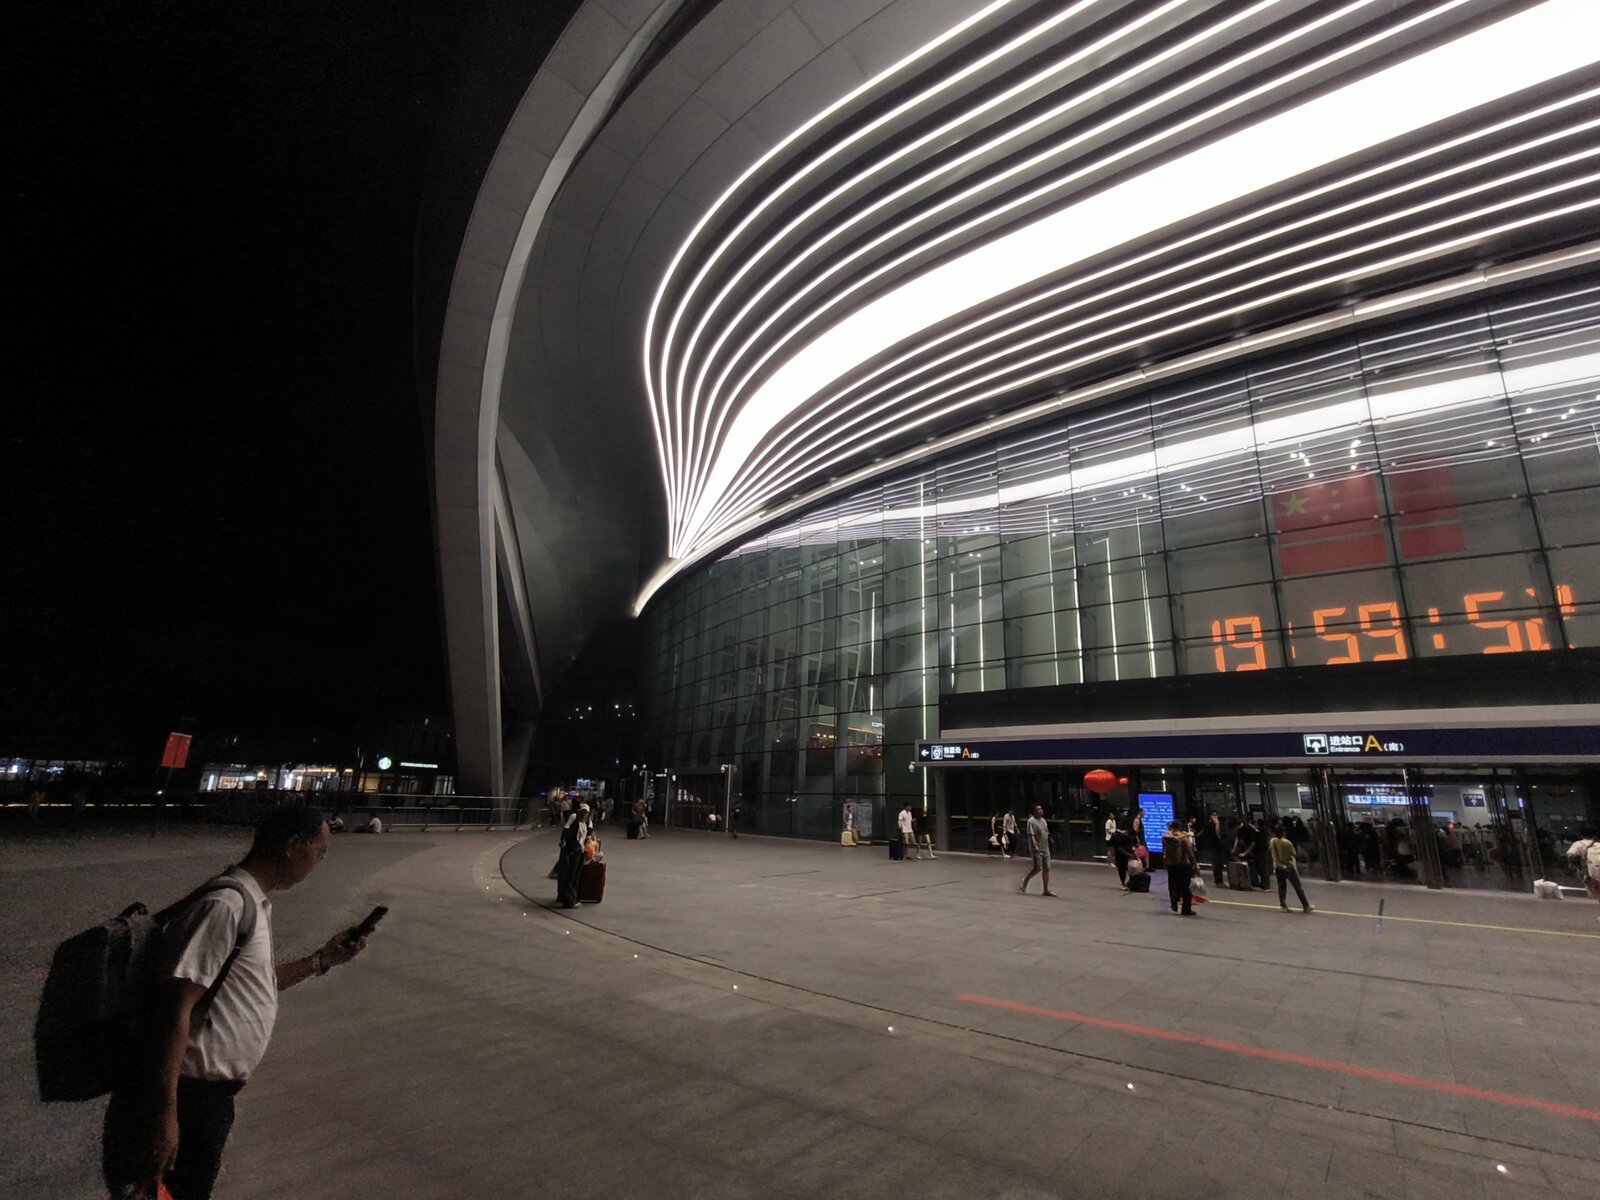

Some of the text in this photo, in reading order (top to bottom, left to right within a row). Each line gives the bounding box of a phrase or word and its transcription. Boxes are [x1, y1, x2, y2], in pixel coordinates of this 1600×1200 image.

[1329, 735, 1363, 746] 进站口
[1364, 735, 1383, 752] A
